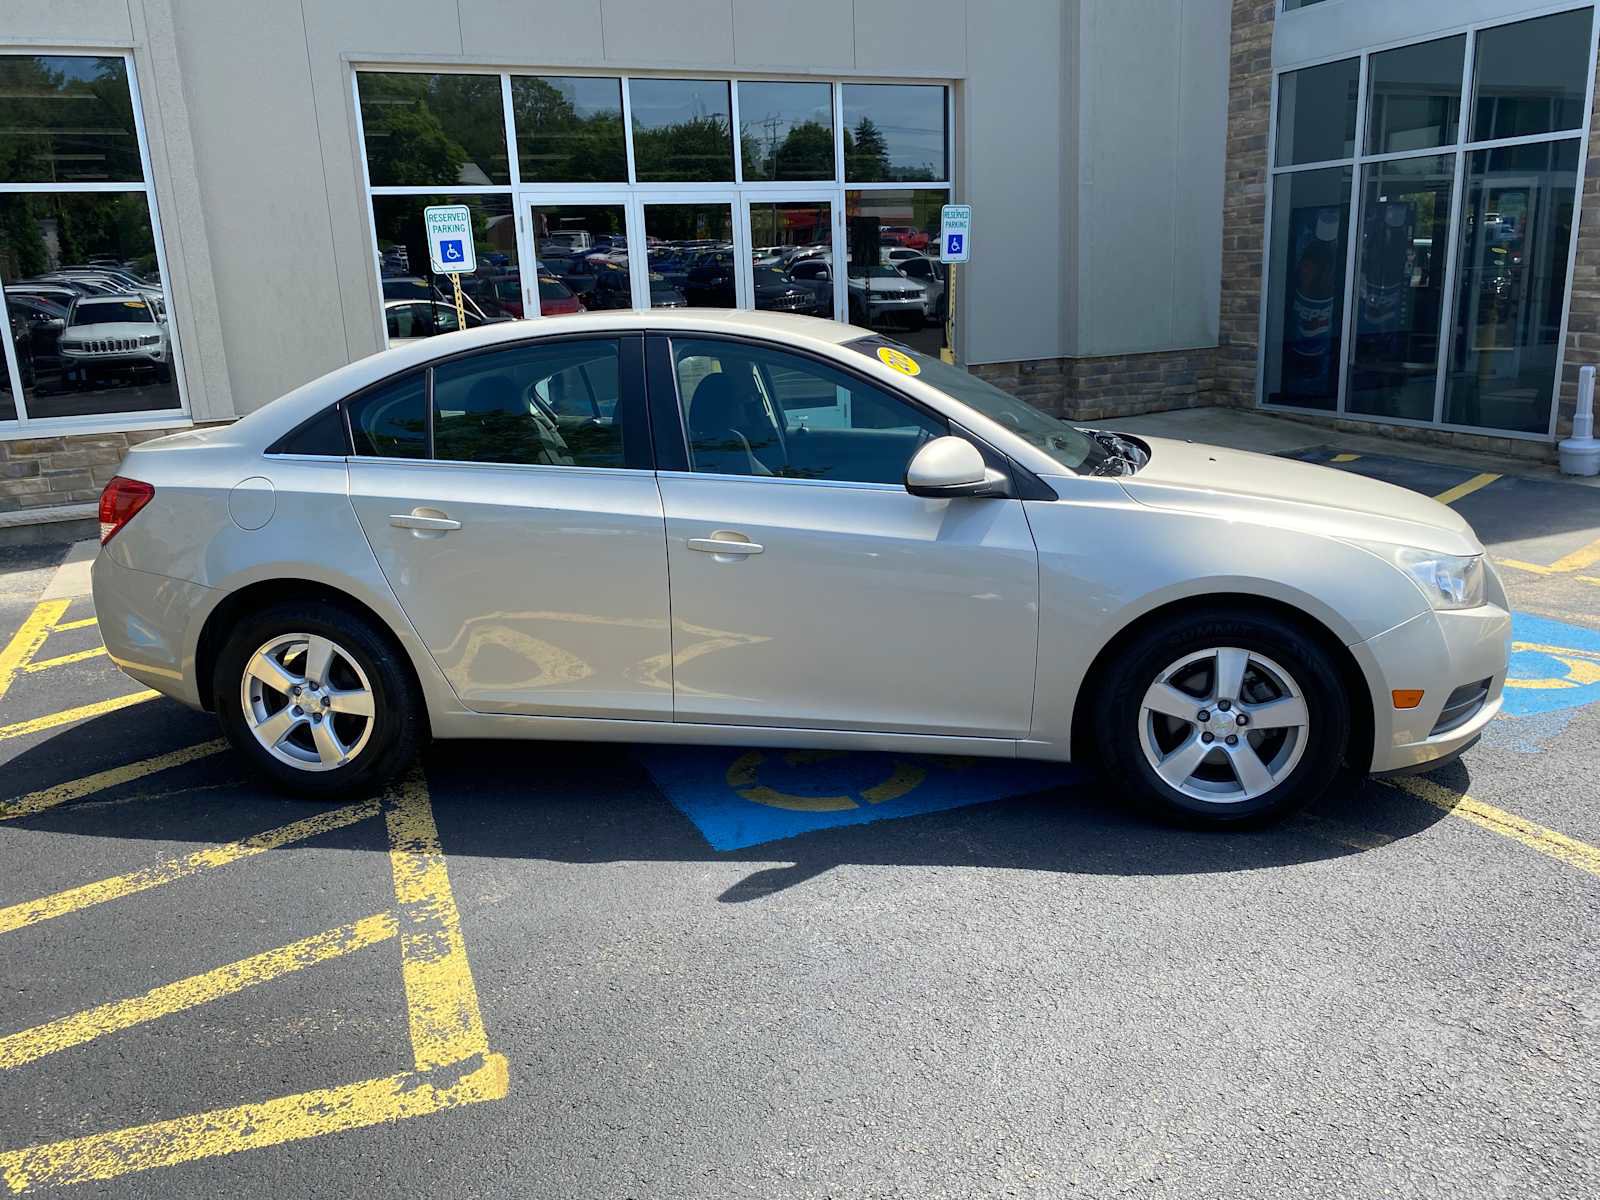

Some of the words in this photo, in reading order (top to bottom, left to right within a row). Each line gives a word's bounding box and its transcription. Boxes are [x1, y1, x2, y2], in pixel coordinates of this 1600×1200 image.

[429, 213, 467, 222] RESERVED
[944, 211, 969, 219] RESERVED
[945, 220, 967, 228] PARKING
[433, 224, 465, 233] PARKING
